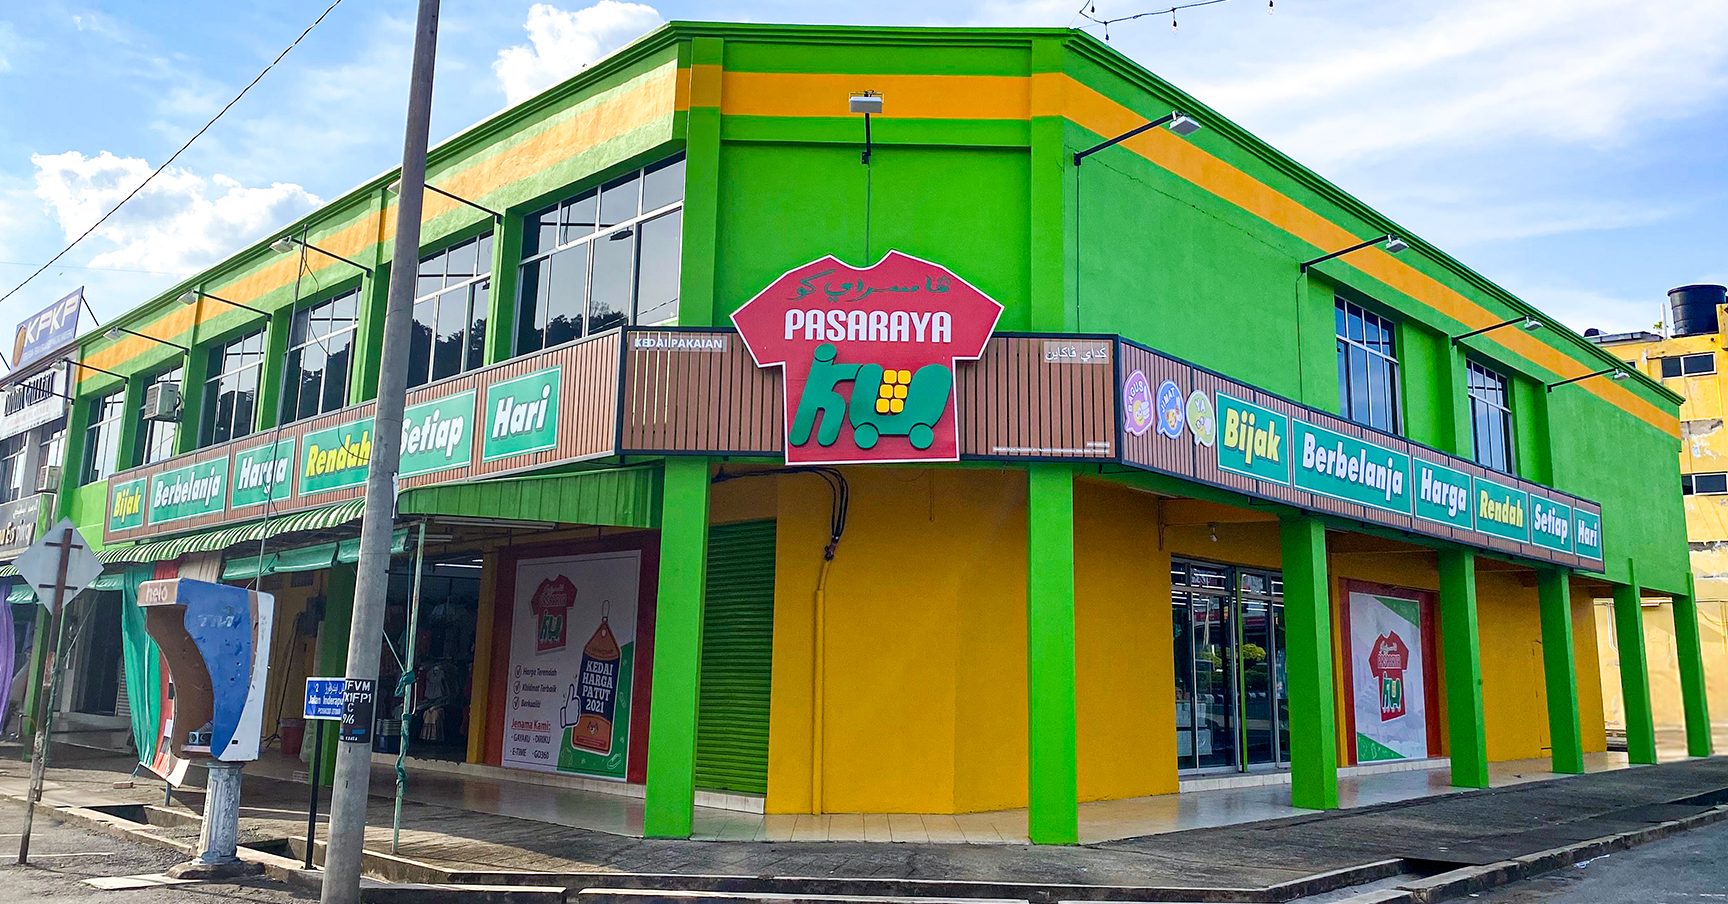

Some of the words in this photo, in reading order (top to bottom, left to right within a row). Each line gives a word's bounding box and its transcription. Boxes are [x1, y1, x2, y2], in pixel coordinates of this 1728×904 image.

[24, 294, 80, 345] KPKP
[785, 309, 952, 343] PASARAYA
[634, 338, 667, 348] KEDAI
[671, 339, 722, 349] PAKAIAN
[1128, 380, 1149, 413] BAGUS
[1161, 387, 1180, 413] JIMAT
[1195, 398, 1206, 413] YA
[113, 489, 140, 517] Bijak
[153, 472, 222, 509] Berbelanja
[237, 454, 288, 494] Harga
[305, 430, 371, 479] Rendah
[398, 410, 464, 461] Setiap
[492, 383, 552, 440] Hari
[1223, 408, 1282, 465] Bijak
[1302, 433, 1403, 501] Berbelanja
[1420, 467, 1468, 518] Harga
[1478, 490, 1525, 530] Rendah
[1533, 502, 1570, 539] Setiap
[1577, 519, 1599, 549] Hari
[586, 660, 614, 676] KEDAI
[582, 672, 614, 689] HARGA
[583, 686, 611, 702] PATUT
[347, 703, 354, 713] C
[585, 699, 604, 713] 2021
